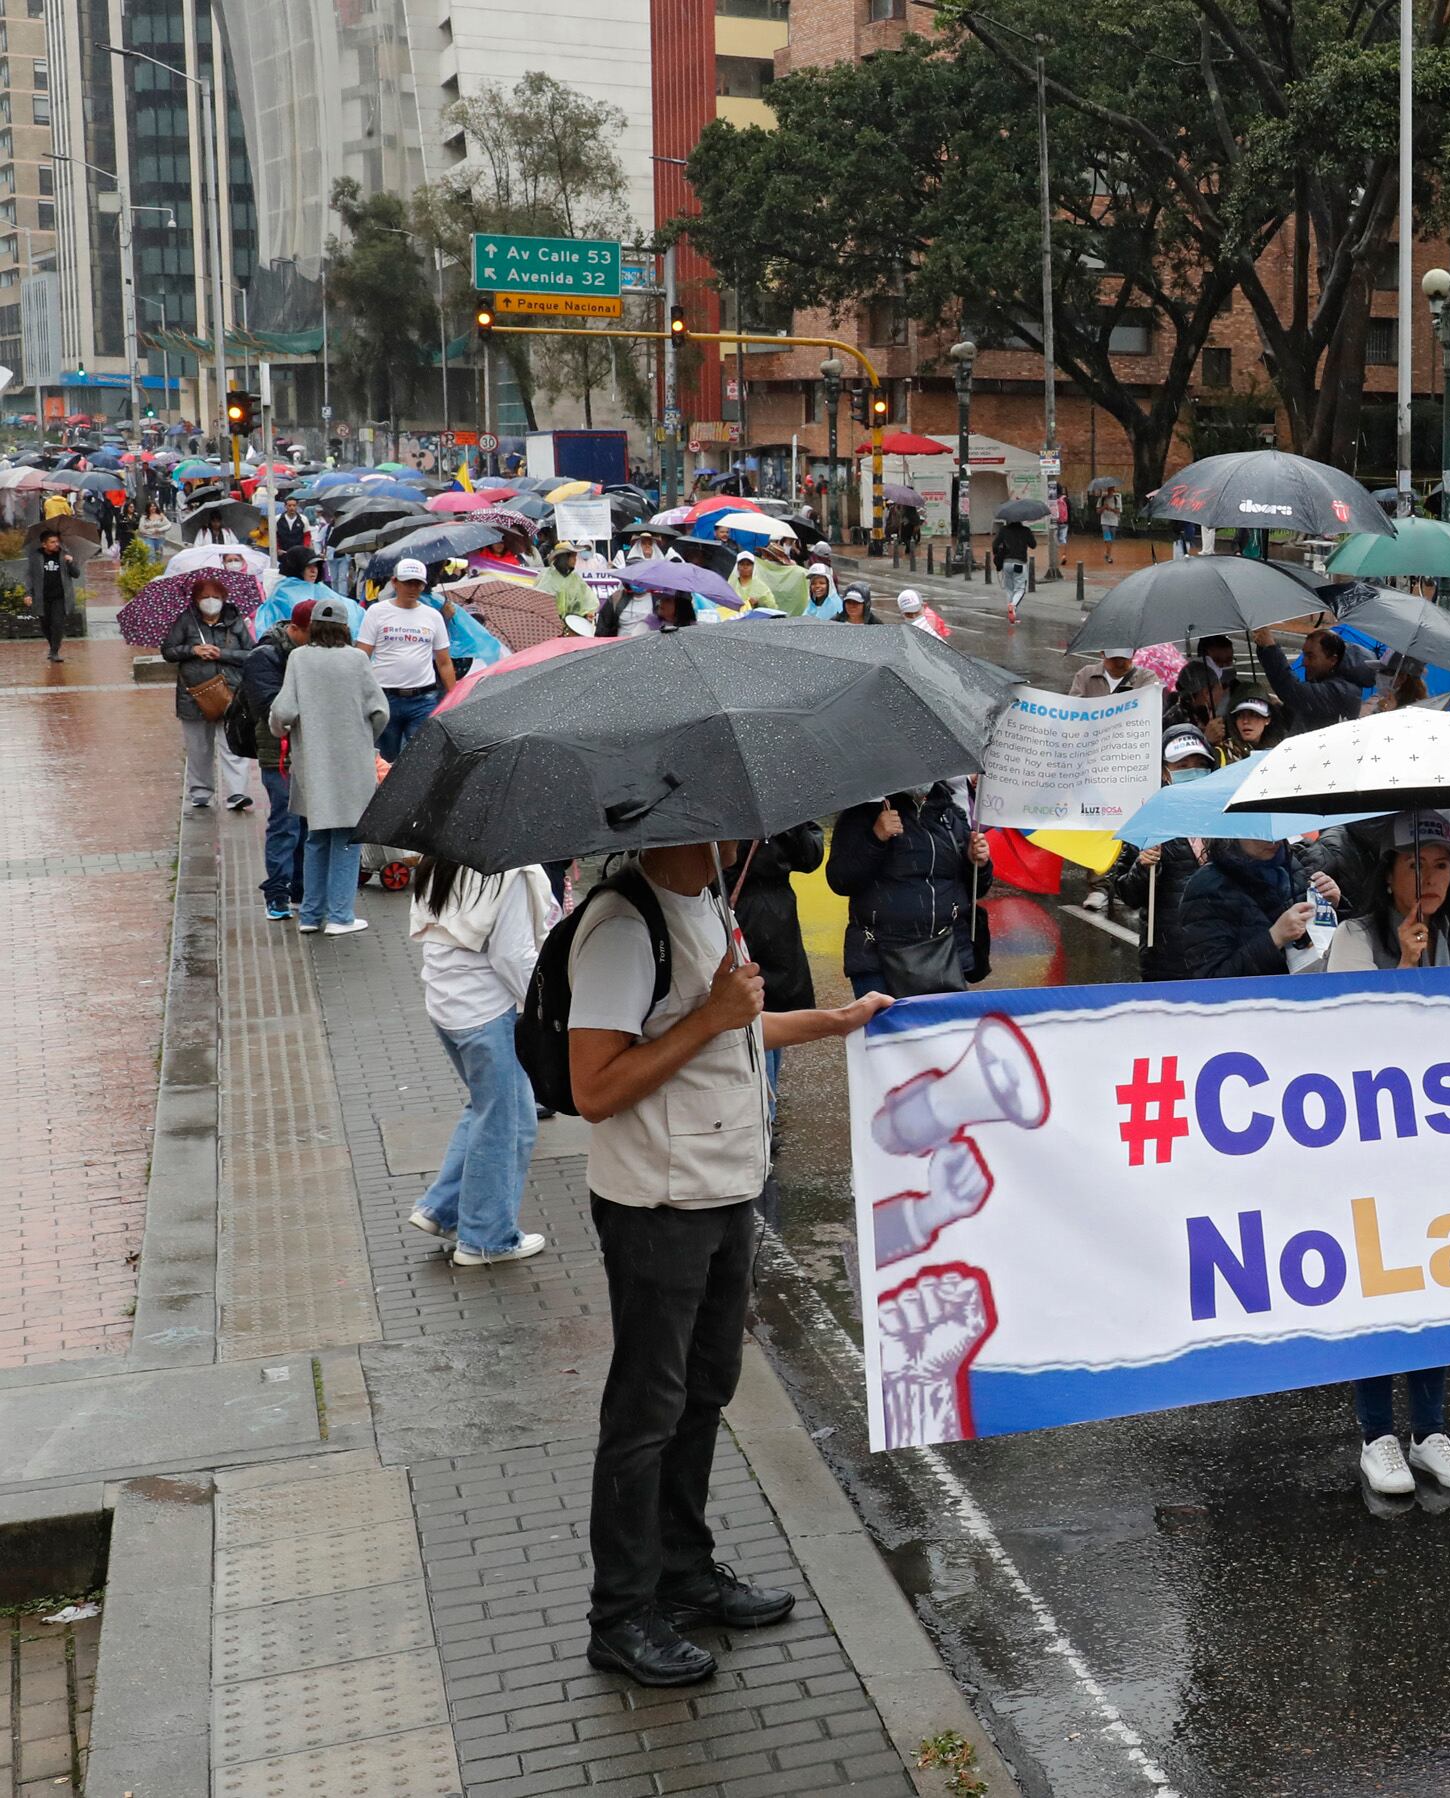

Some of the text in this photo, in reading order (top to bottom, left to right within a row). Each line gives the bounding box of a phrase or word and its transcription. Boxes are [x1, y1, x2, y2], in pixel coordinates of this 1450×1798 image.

[506, 246, 612, 264] Av Calle 53
[507, 268, 574, 285] Avenida
[581, 272, 606, 286] 32
[517, 298, 616, 313] Parque Nacional
[482, 438, 495, 448] 30
[1238, 499, 1292, 516] doors
[1005, 730, 1060, 748] tratamientos
[1126, 730, 1151, 740] sigan
[1019, 723, 1058, 737] probable
[1062, 731, 1080, 739] que
[1040, 750, 1052, 758] en
[1055, 750, 1067, 759] las
[1100, 741, 1138, 753] privadas
[1003, 753, 1021, 764] que
[1024, 757, 1041, 769] hoy
[1046, 759, 1073, 769] están
[1100, 753, 1141, 761] cambien
[987, 761, 1008, 772] otras
[1009, 766, 1021, 775] en
[1022, 768, 1036, 777] las
[1038, 771, 1057, 779] que
[1091, 765, 1110, 773] que
[1021, 779, 1056, 789] incluso
[1057, 782, 1075, 790] con
[1084, 776, 1117, 785] historia
